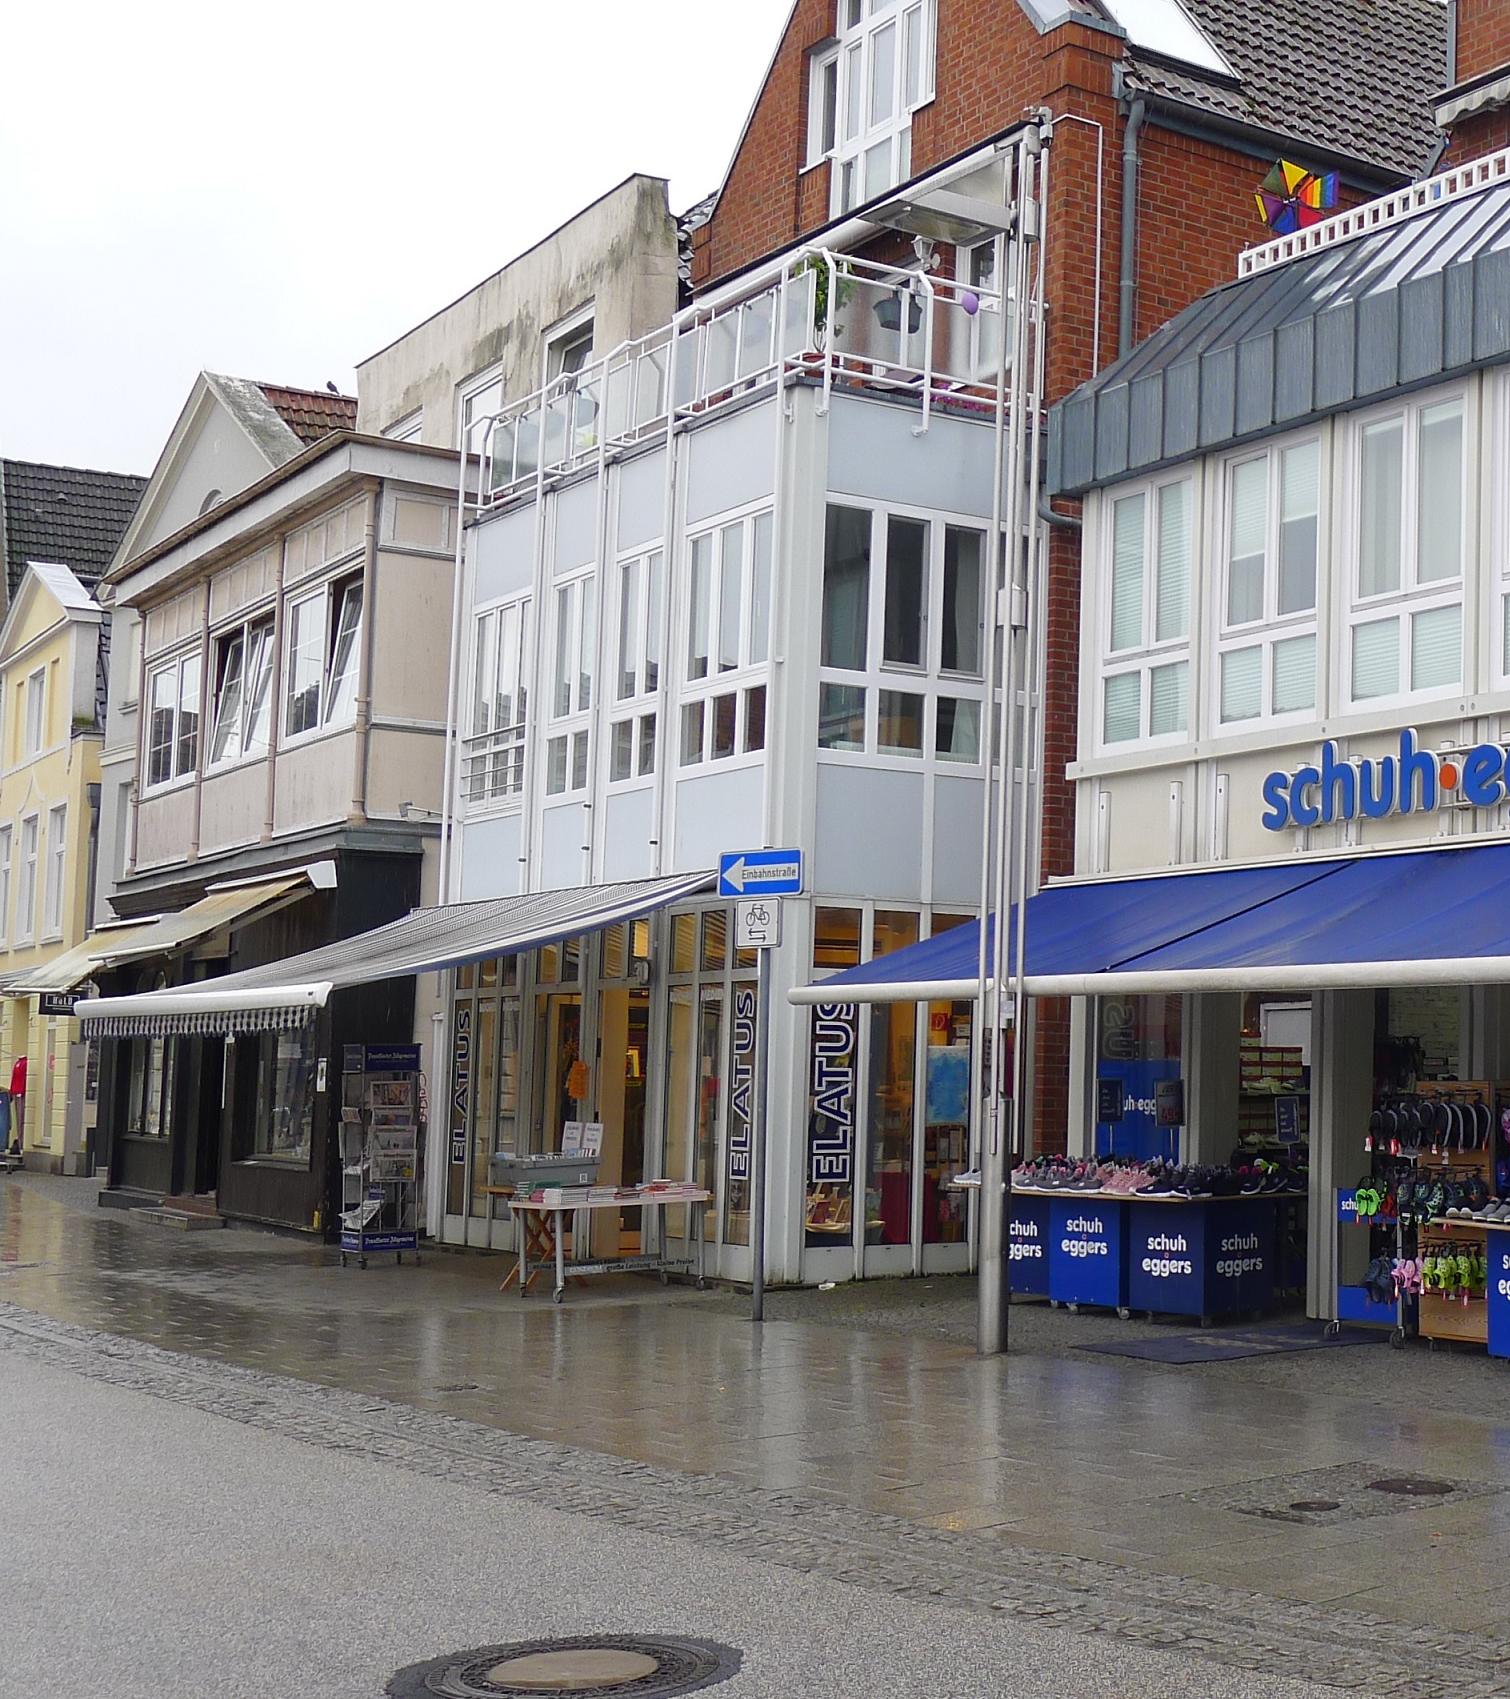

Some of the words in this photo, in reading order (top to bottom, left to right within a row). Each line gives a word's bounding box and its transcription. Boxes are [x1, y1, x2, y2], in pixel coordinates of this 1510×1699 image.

[742, 867, 796, 879] Einbahnstraße
[452, 1008, 471, 1165] ELATUS
[729, 988, 755, 1180] ELATUS
[812, 1003, 855, 1183] ELATUS
[1136, 1097, 1157, 1115] egg
[1341, 1197, 1359, 1210] schu
[1009, 1219, 1038, 1237] chuh
[1066, 1216, 1103, 1234] schuh
[1009, 1243, 1042, 1260] ggers
[1061, 1238, 1108, 1257] eggers
[1147, 1233, 1187, 1252] schuh
[1221, 1233, 1258, 1252] schuh
[1142, 1257, 1192, 1277] eggers
[1216, 1256, 1263, 1277] eggers
